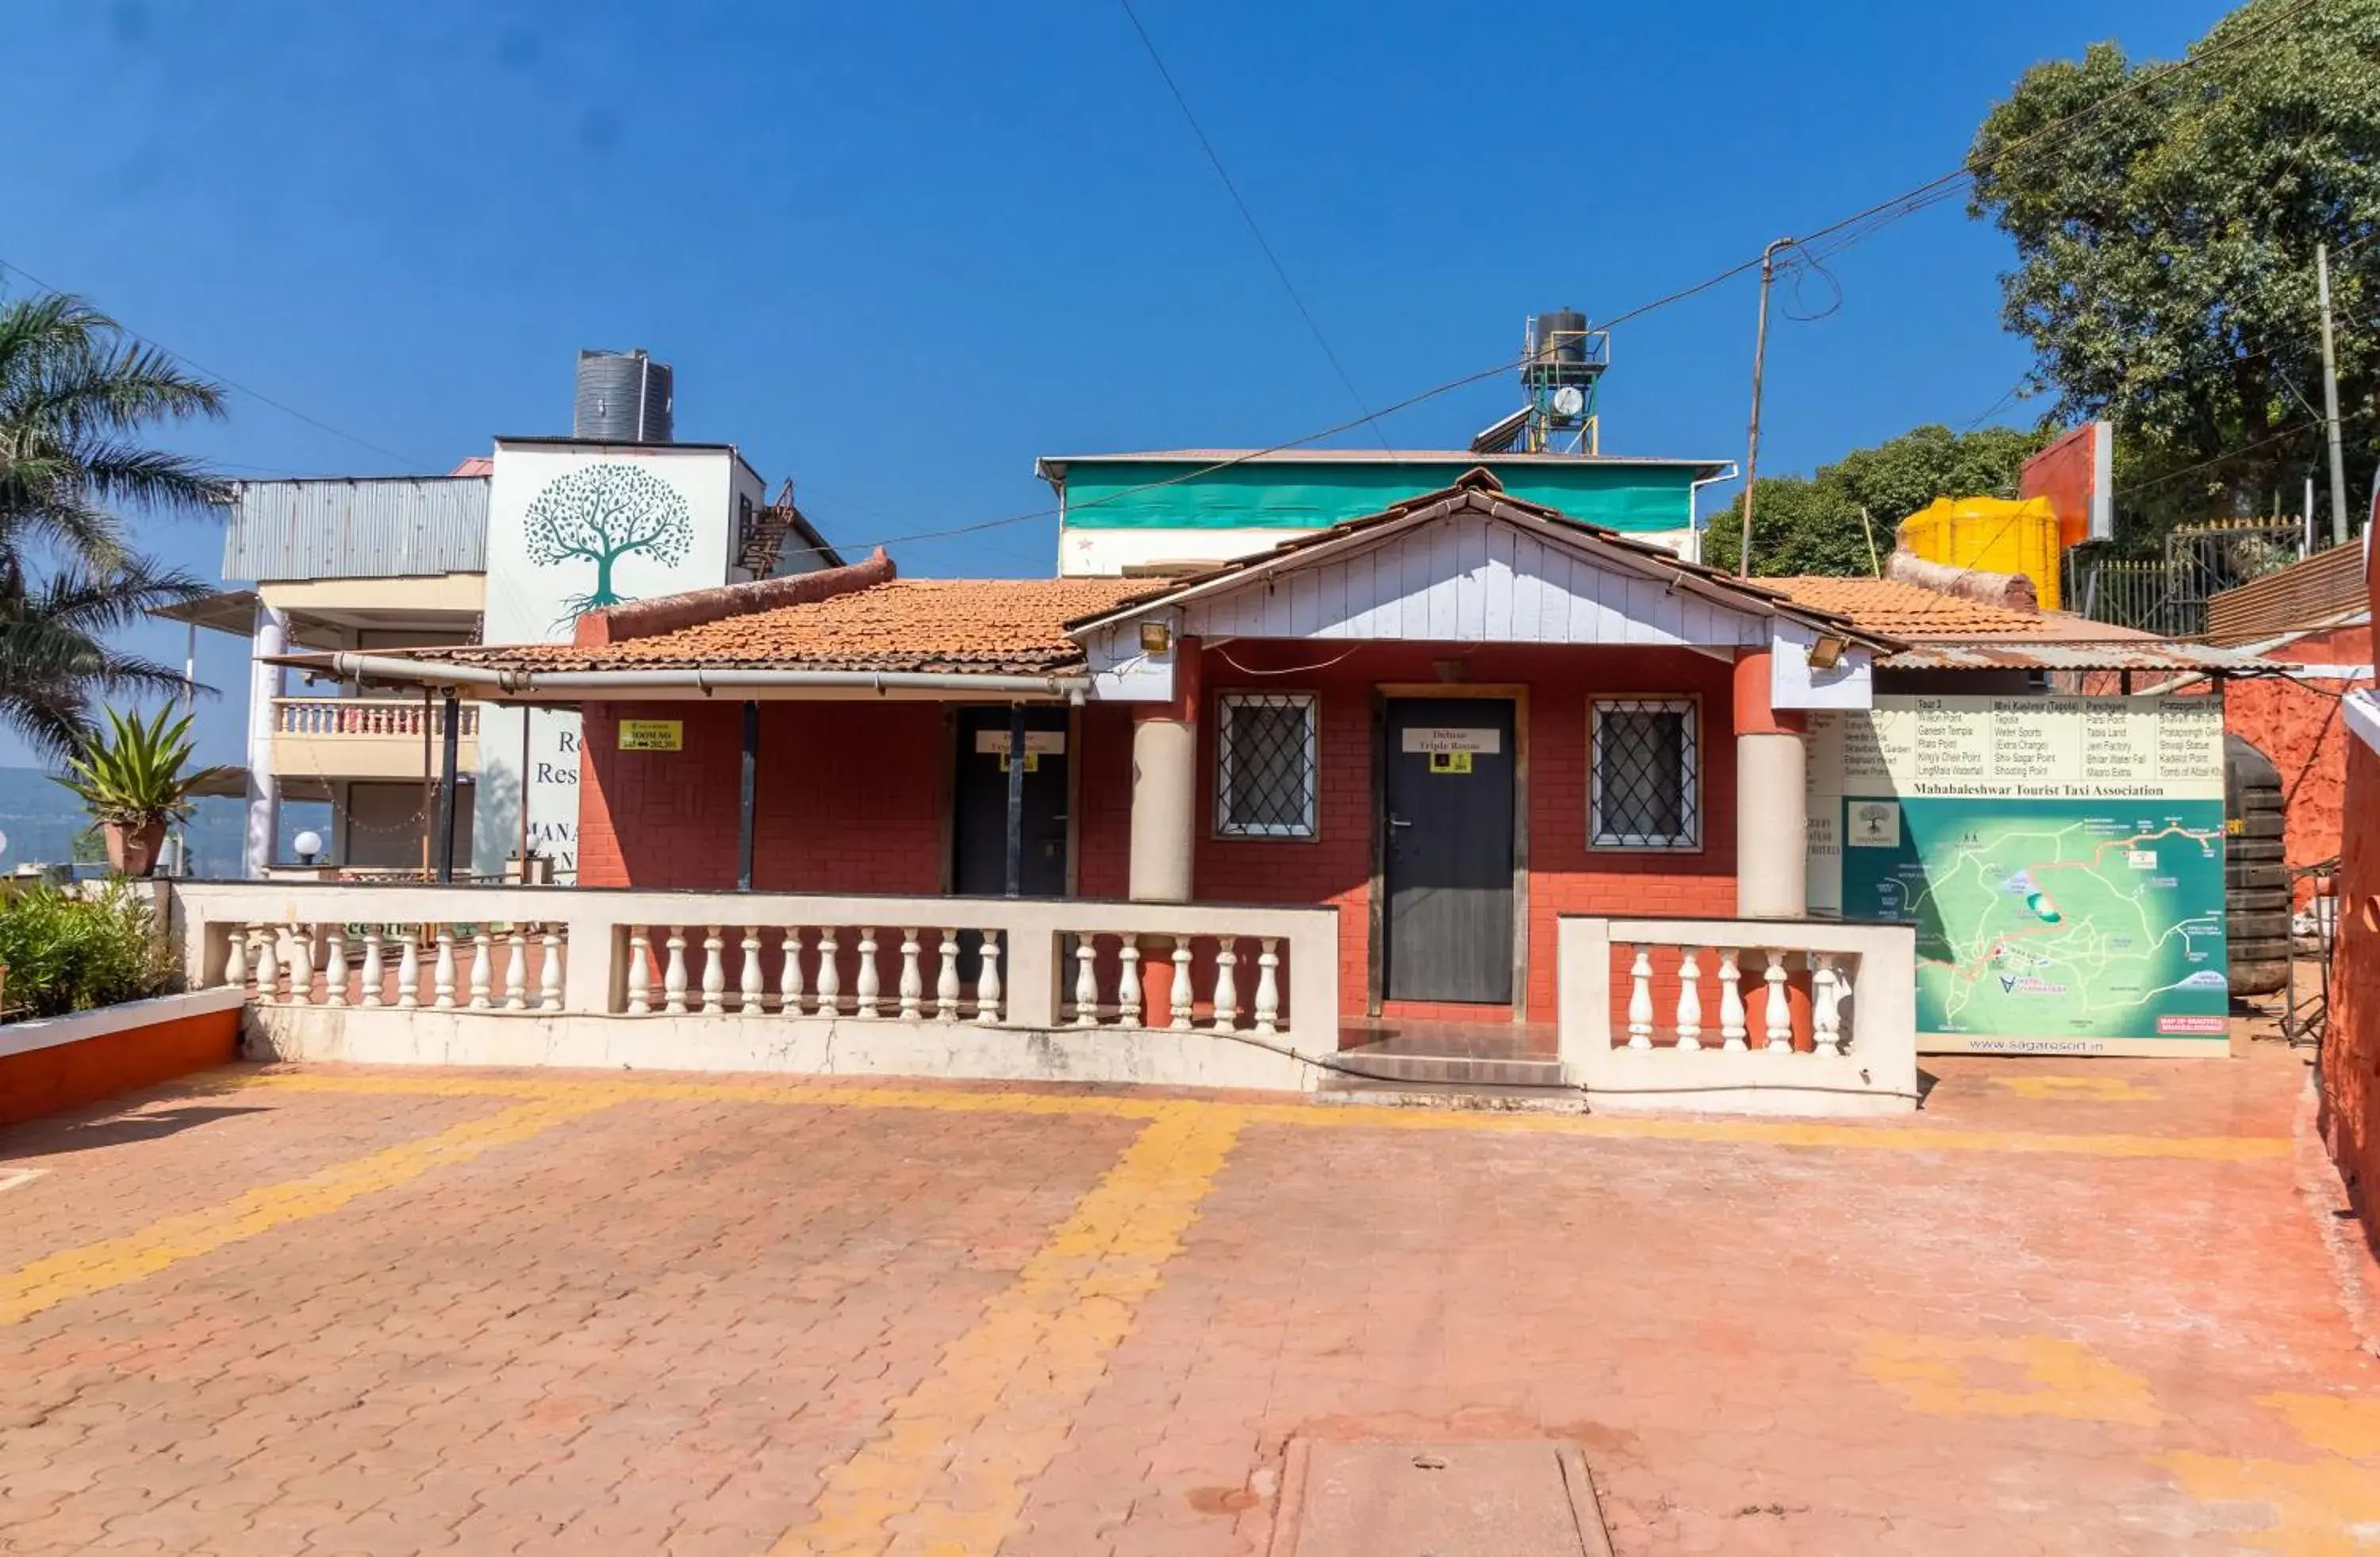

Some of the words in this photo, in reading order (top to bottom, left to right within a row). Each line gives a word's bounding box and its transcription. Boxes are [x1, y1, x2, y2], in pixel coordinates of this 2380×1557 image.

[1918, 699, 1934, 709] Tour
[2013, 701, 2045, 710] Kashmir
[1944, 713, 1962, 722] Point
[1963, 752, 1981, 762] Point
[2036, 753, 2056, 763] Point
[2029, 767, 2048, 775] Point
[1914, 782, 2012, 795] Mahabaleshwar
[2017, 784, 2059, 795] Tourist
[2063, 784, 2090, 796] Taxi
[2092, 784, 2164, 796] Association
